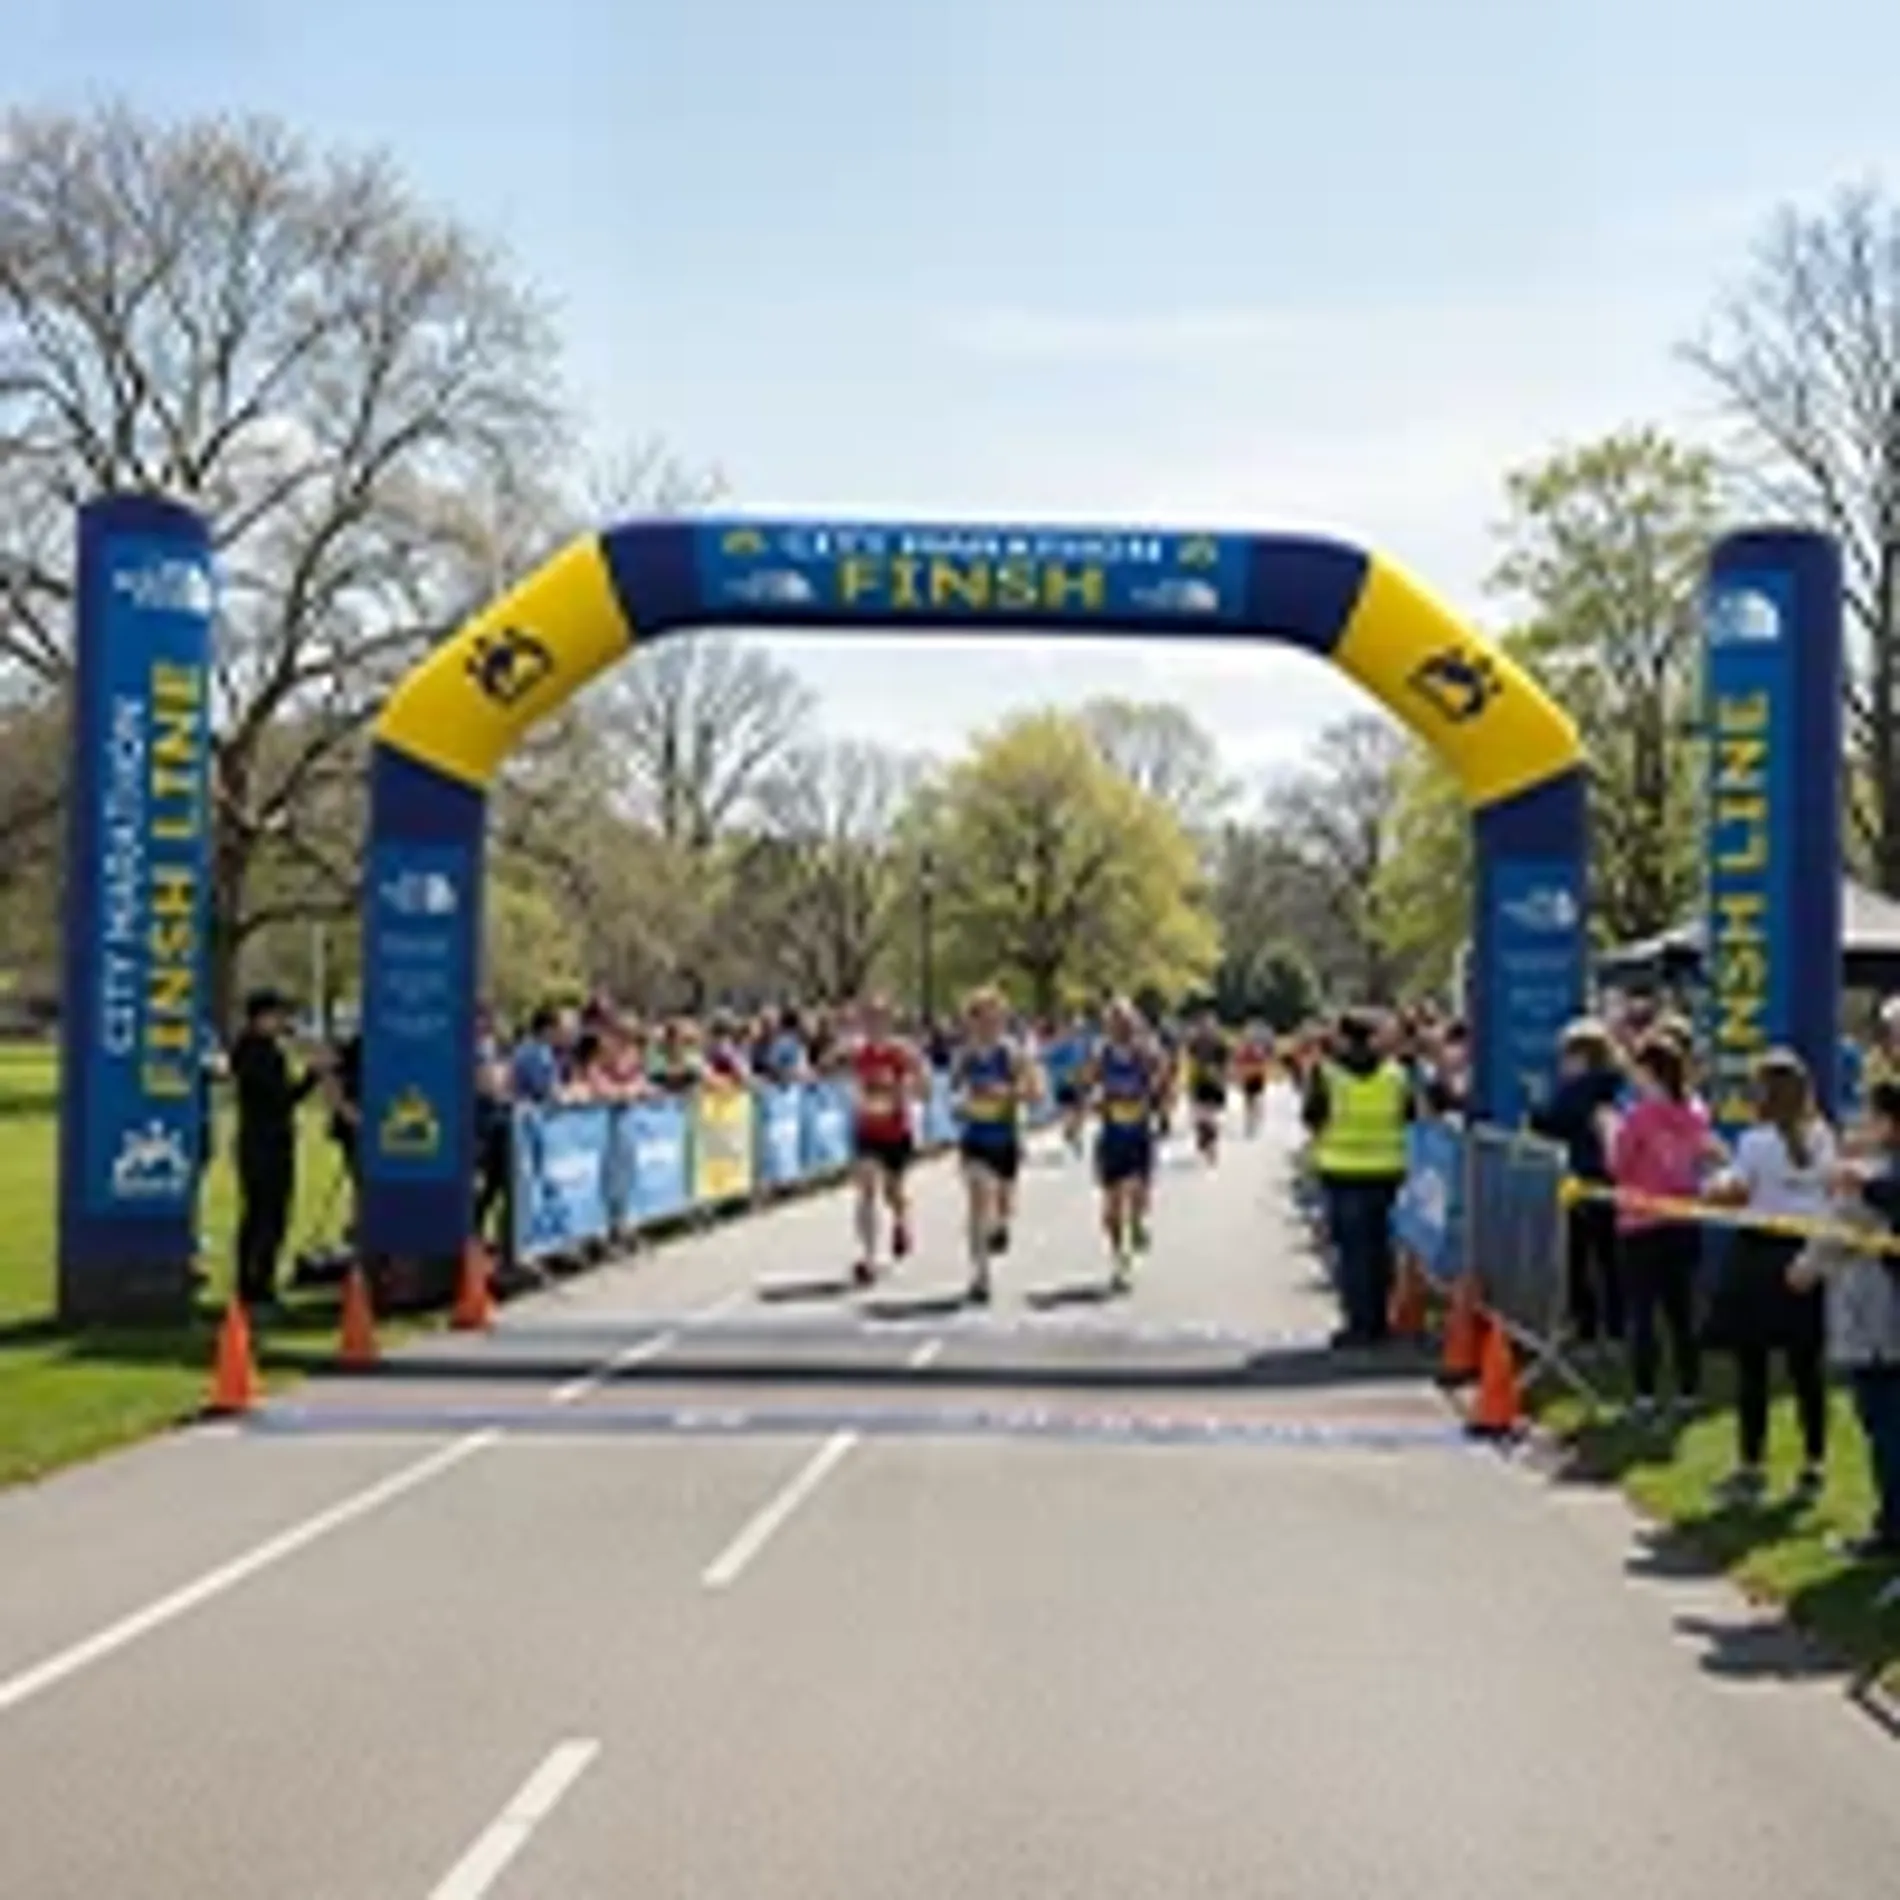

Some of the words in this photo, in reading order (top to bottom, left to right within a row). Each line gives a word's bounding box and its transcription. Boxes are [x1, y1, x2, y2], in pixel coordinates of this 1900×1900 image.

[838, 557, 1106, 610] FINSH
[152, 662, 203, 839] LINE
[1717, 690, 1769, 873] LINE
[103, 950, 137, 1055] CITY
[142, 865, 197, 1097] FINSH
